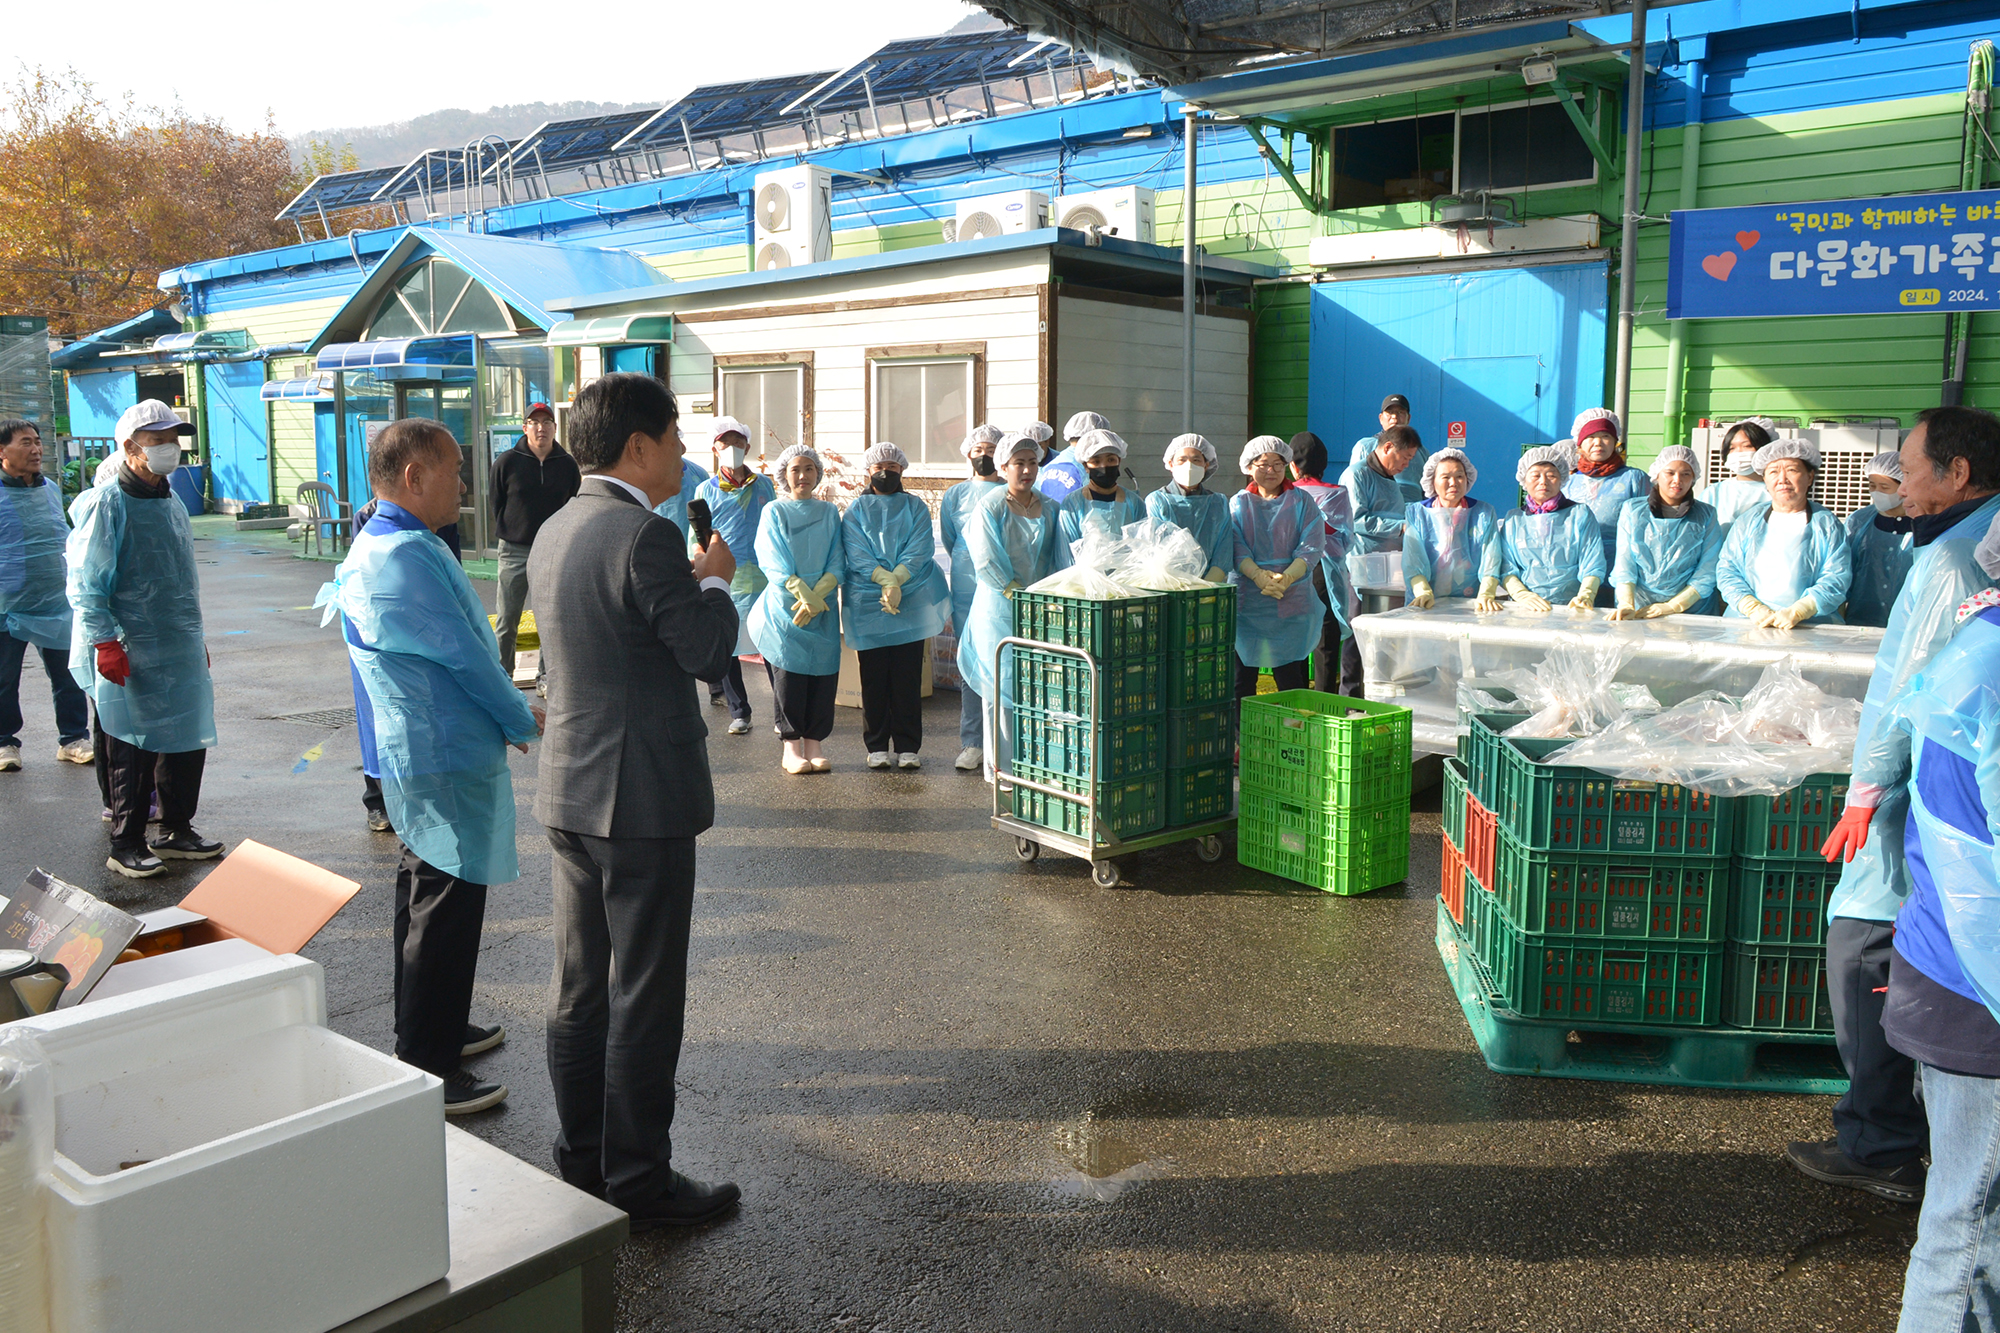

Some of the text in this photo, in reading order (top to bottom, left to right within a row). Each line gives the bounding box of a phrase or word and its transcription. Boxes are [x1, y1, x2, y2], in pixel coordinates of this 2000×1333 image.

[1861, 203, 1957, 230] 함께하는
[1948, 289, 1989, 302] 2024.
[5, 920, 29, 941] 고당도
